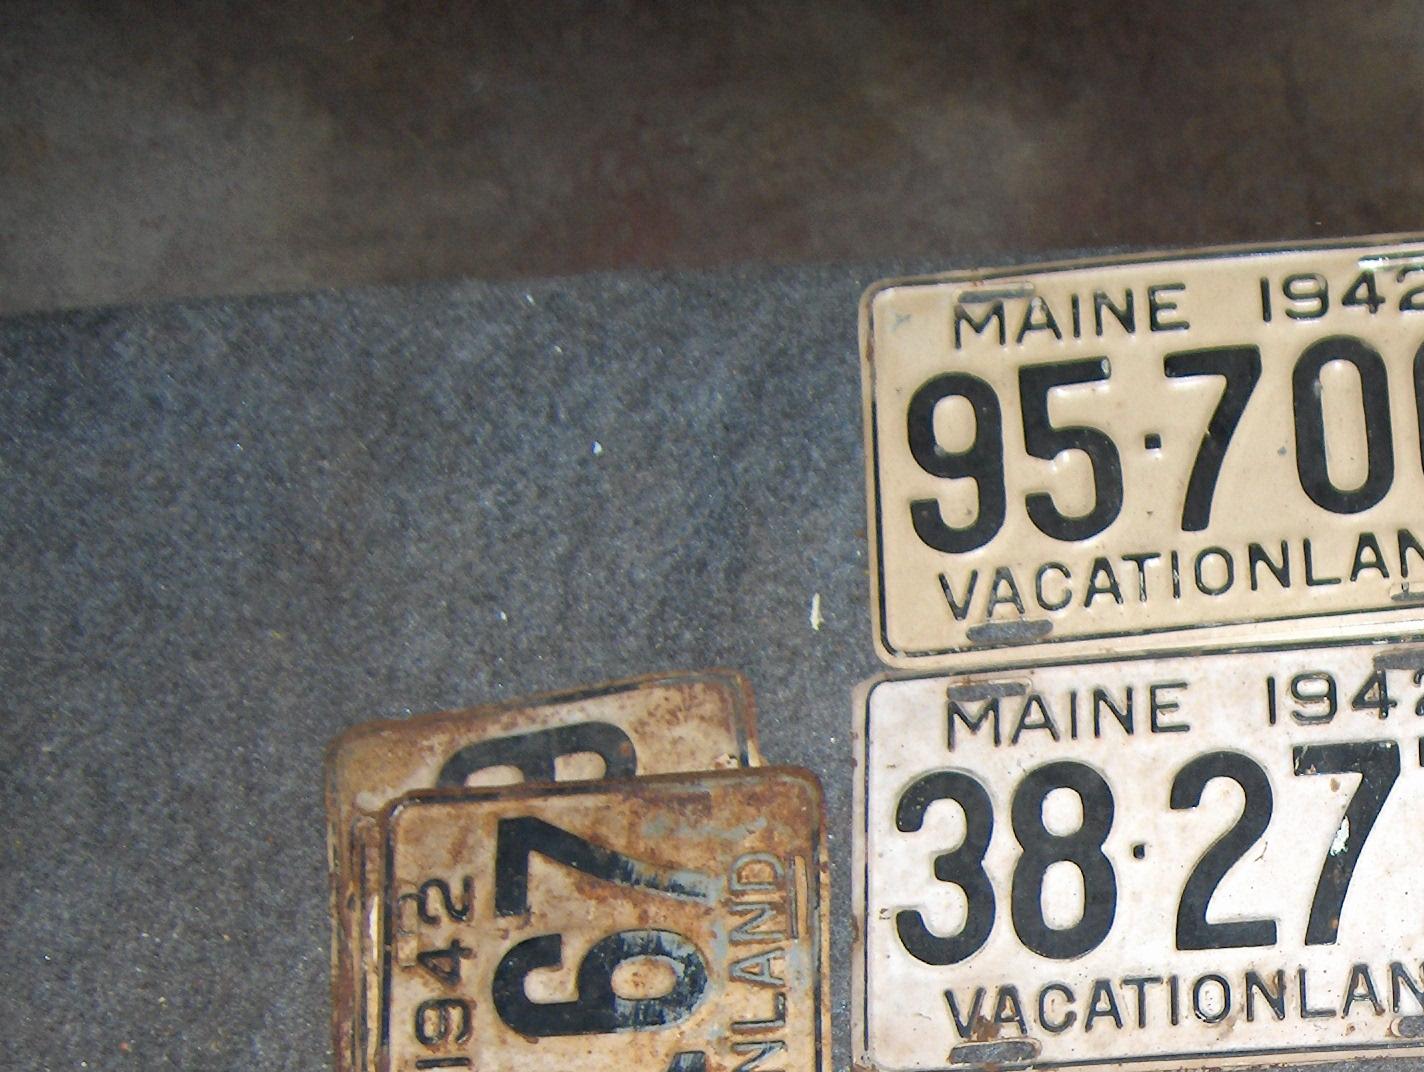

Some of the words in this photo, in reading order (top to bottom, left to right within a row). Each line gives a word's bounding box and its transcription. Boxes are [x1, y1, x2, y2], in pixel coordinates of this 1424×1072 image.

[954, 282, 1190, 350] MAINE
[946, 682, 1191, 751] MAINE
[413, 873, 474, 1071] 1942
